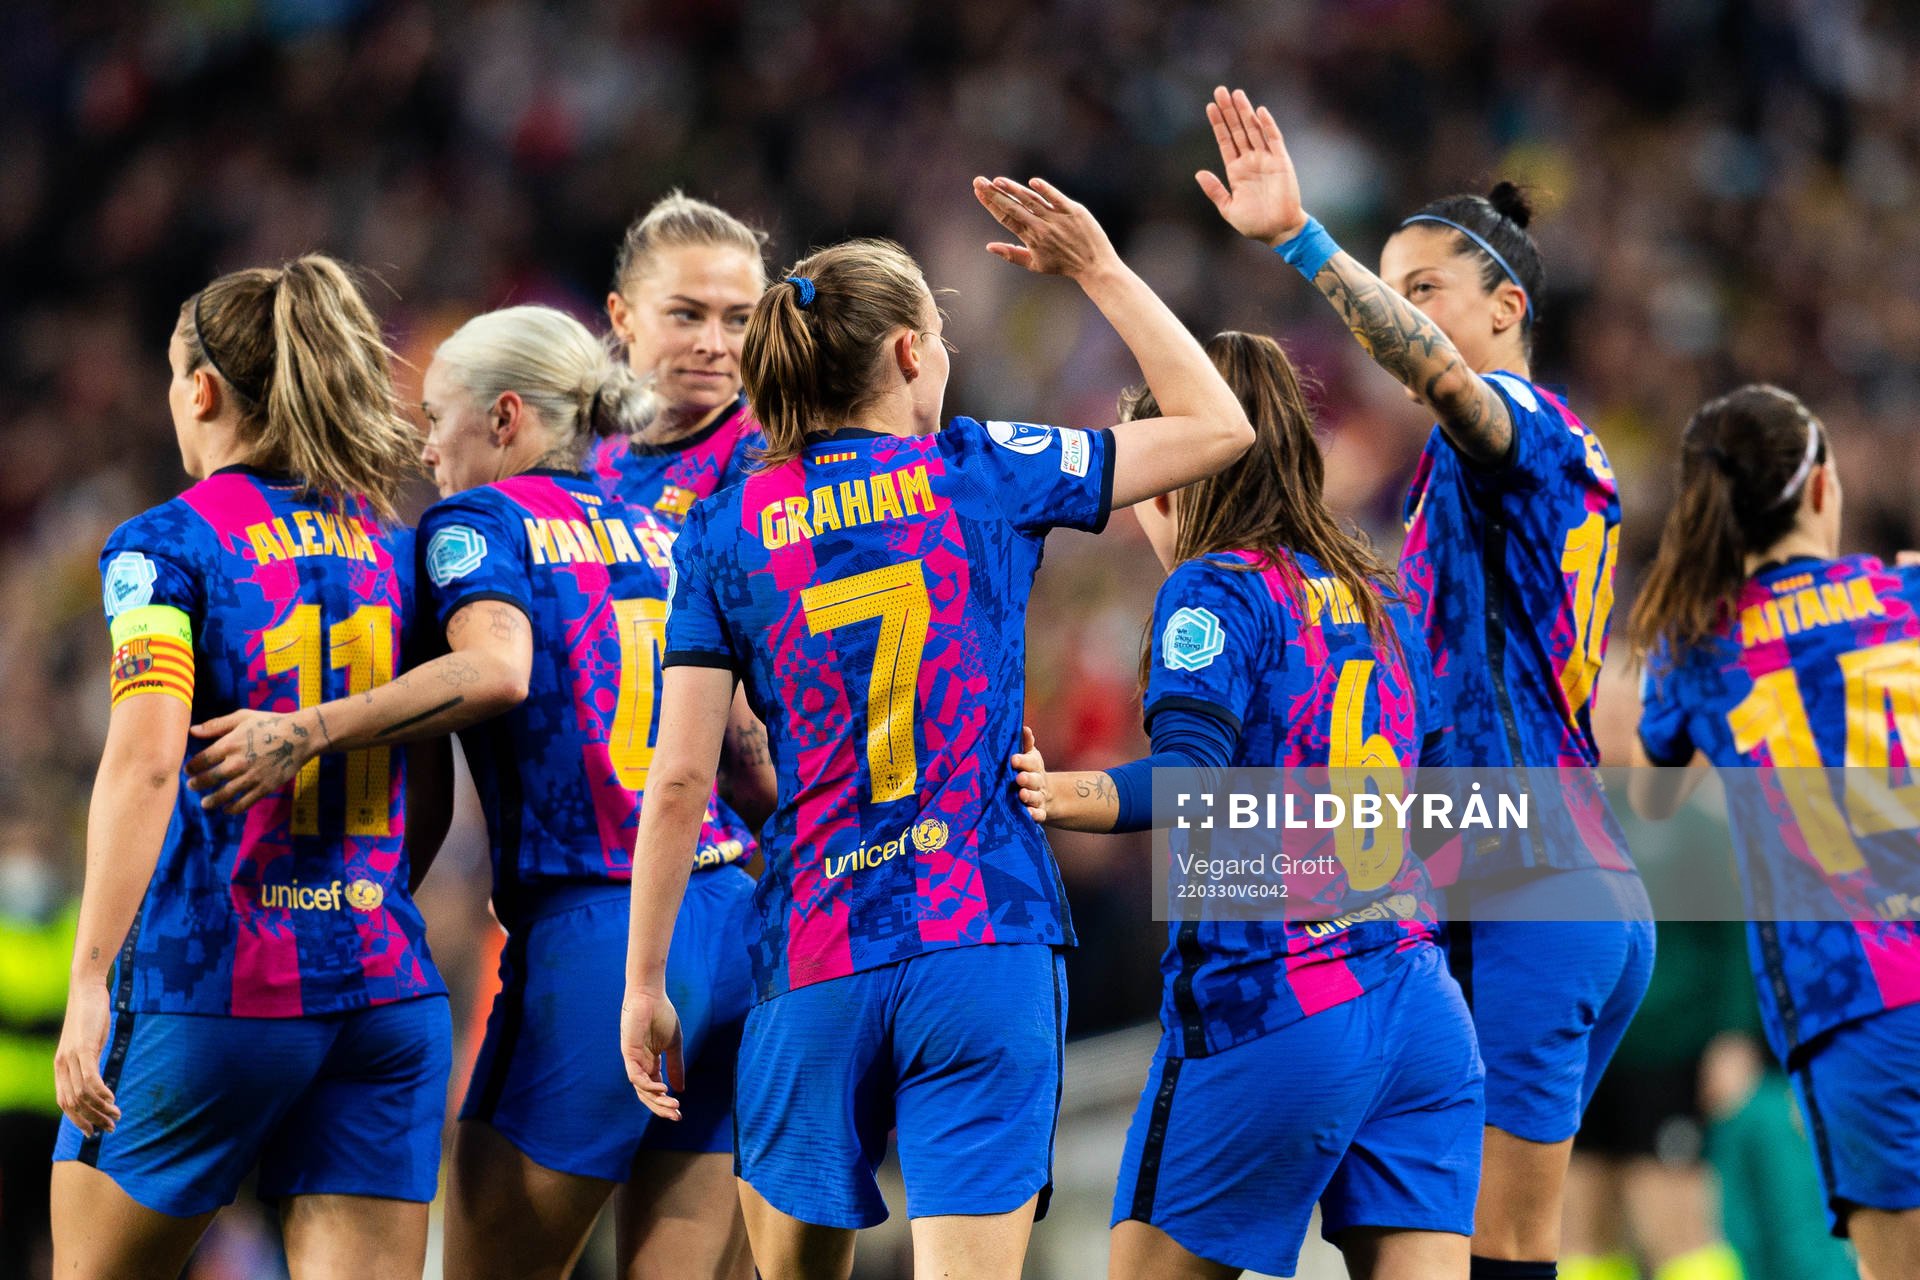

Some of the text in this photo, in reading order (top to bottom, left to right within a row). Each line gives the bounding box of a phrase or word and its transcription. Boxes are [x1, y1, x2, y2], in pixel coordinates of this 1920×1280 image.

[245, 511, 377, 566] ALEXIA
[761, 465, 936, 550] GRAHAM
[1741, 576, 1886, 648] AITANA
[800, 559, 932, 804] 7
[262, 604, 393, 836] 11
[1327, 660, 1405, 892] 6
[825, 826, 910, 880] unicef
[261, 879, 342, 911] unicef
[1305, 901, 1390, 938] unicef
